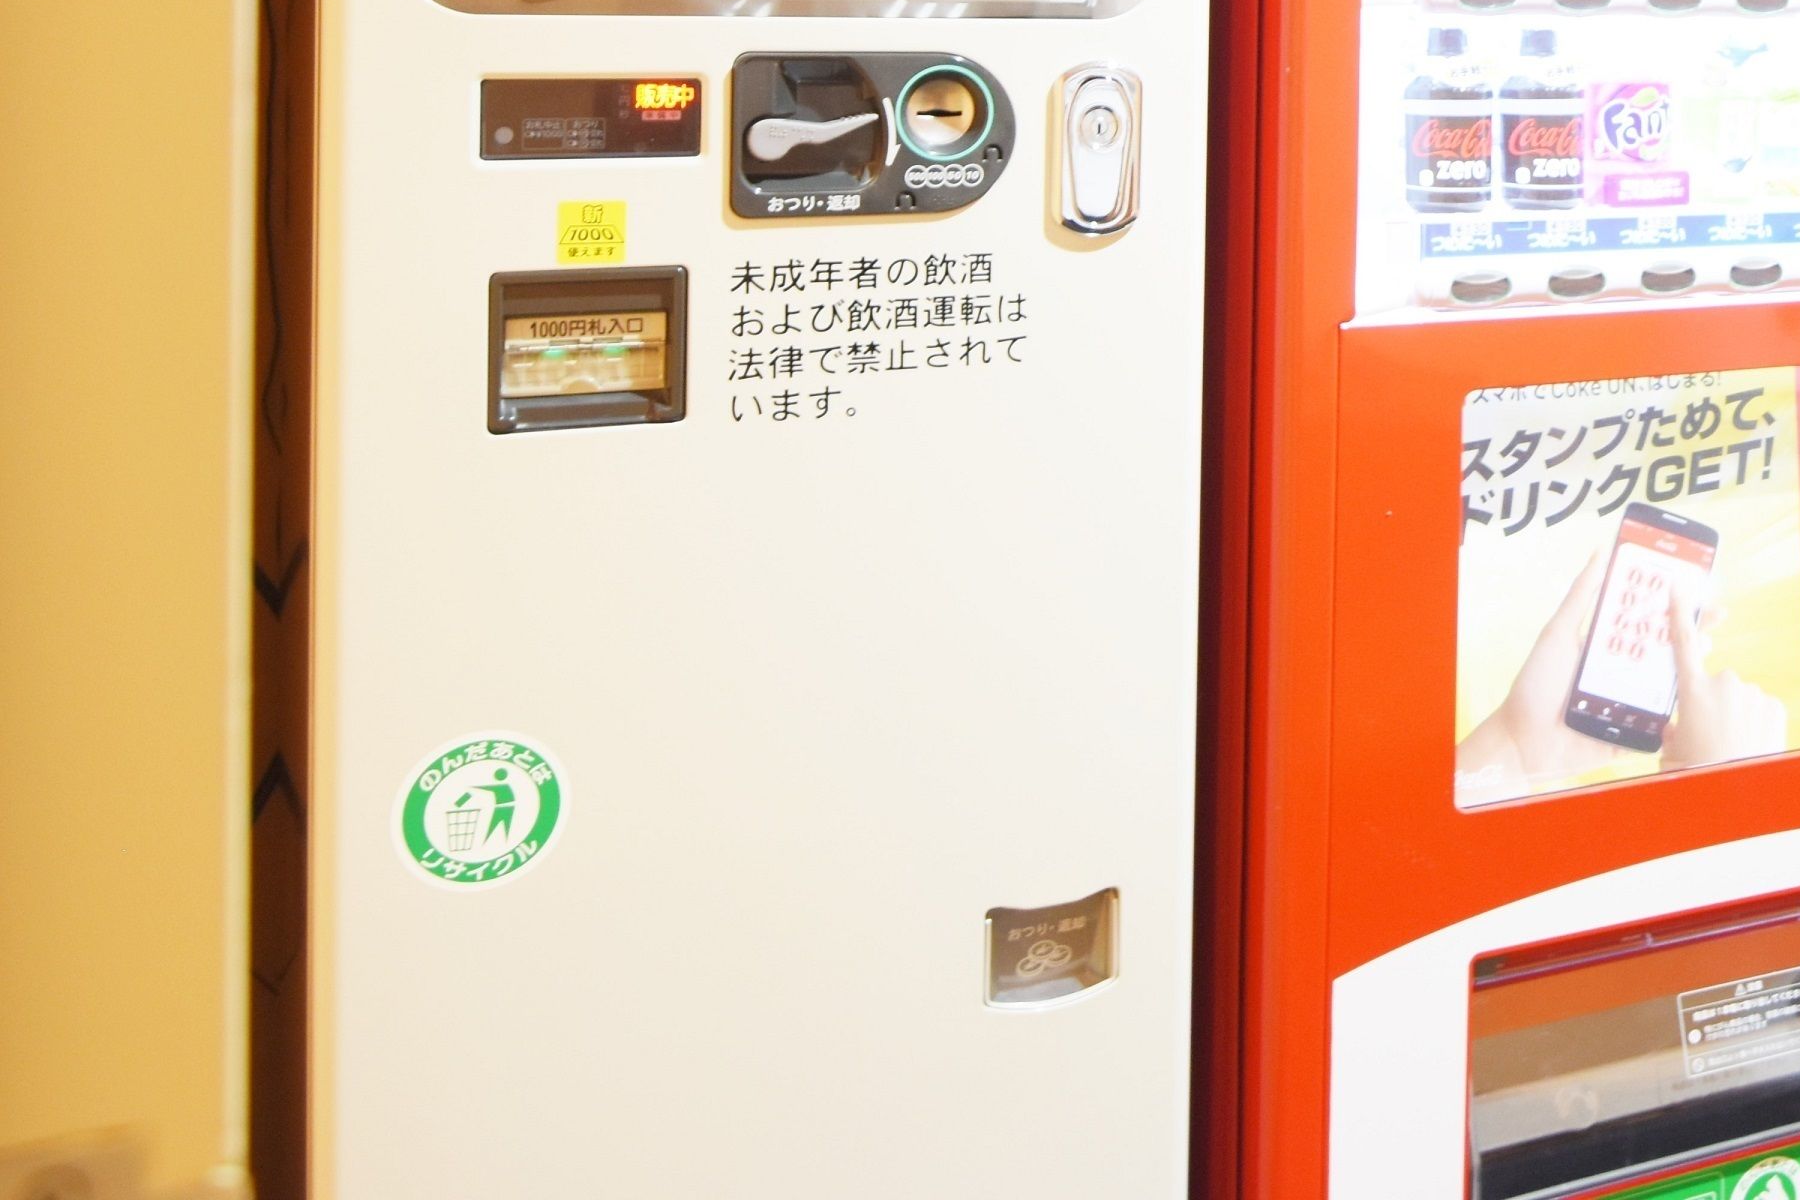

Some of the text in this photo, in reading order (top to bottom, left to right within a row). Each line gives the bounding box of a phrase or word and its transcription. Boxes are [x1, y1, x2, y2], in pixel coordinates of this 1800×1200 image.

[635, 83, 695, 109] 販売中
[1436, 159, 1487, 181] zero
[1532, 158, 1581, 178] zero
[767, 194, 861, 212] おつり・返却
[569, 227, 615, 241] 1000
[729, 252, 994, 295] 未成年者の飲酒
[529, 316, 645, 339] 1000円札入口
[729, 293, 1028, 339] および飲酒運転は
[728, 334, 1029, 383] 法律で禁止されて
[730, 385, 859, 424] います。
[1462, 386, 1776, 481] スタンプためて、
[1461, 436, 1775, 537] ドリンクGET!
[418, 741, 552, 792] のんだあとは
[420, 840, 538, 881] リサイクル
